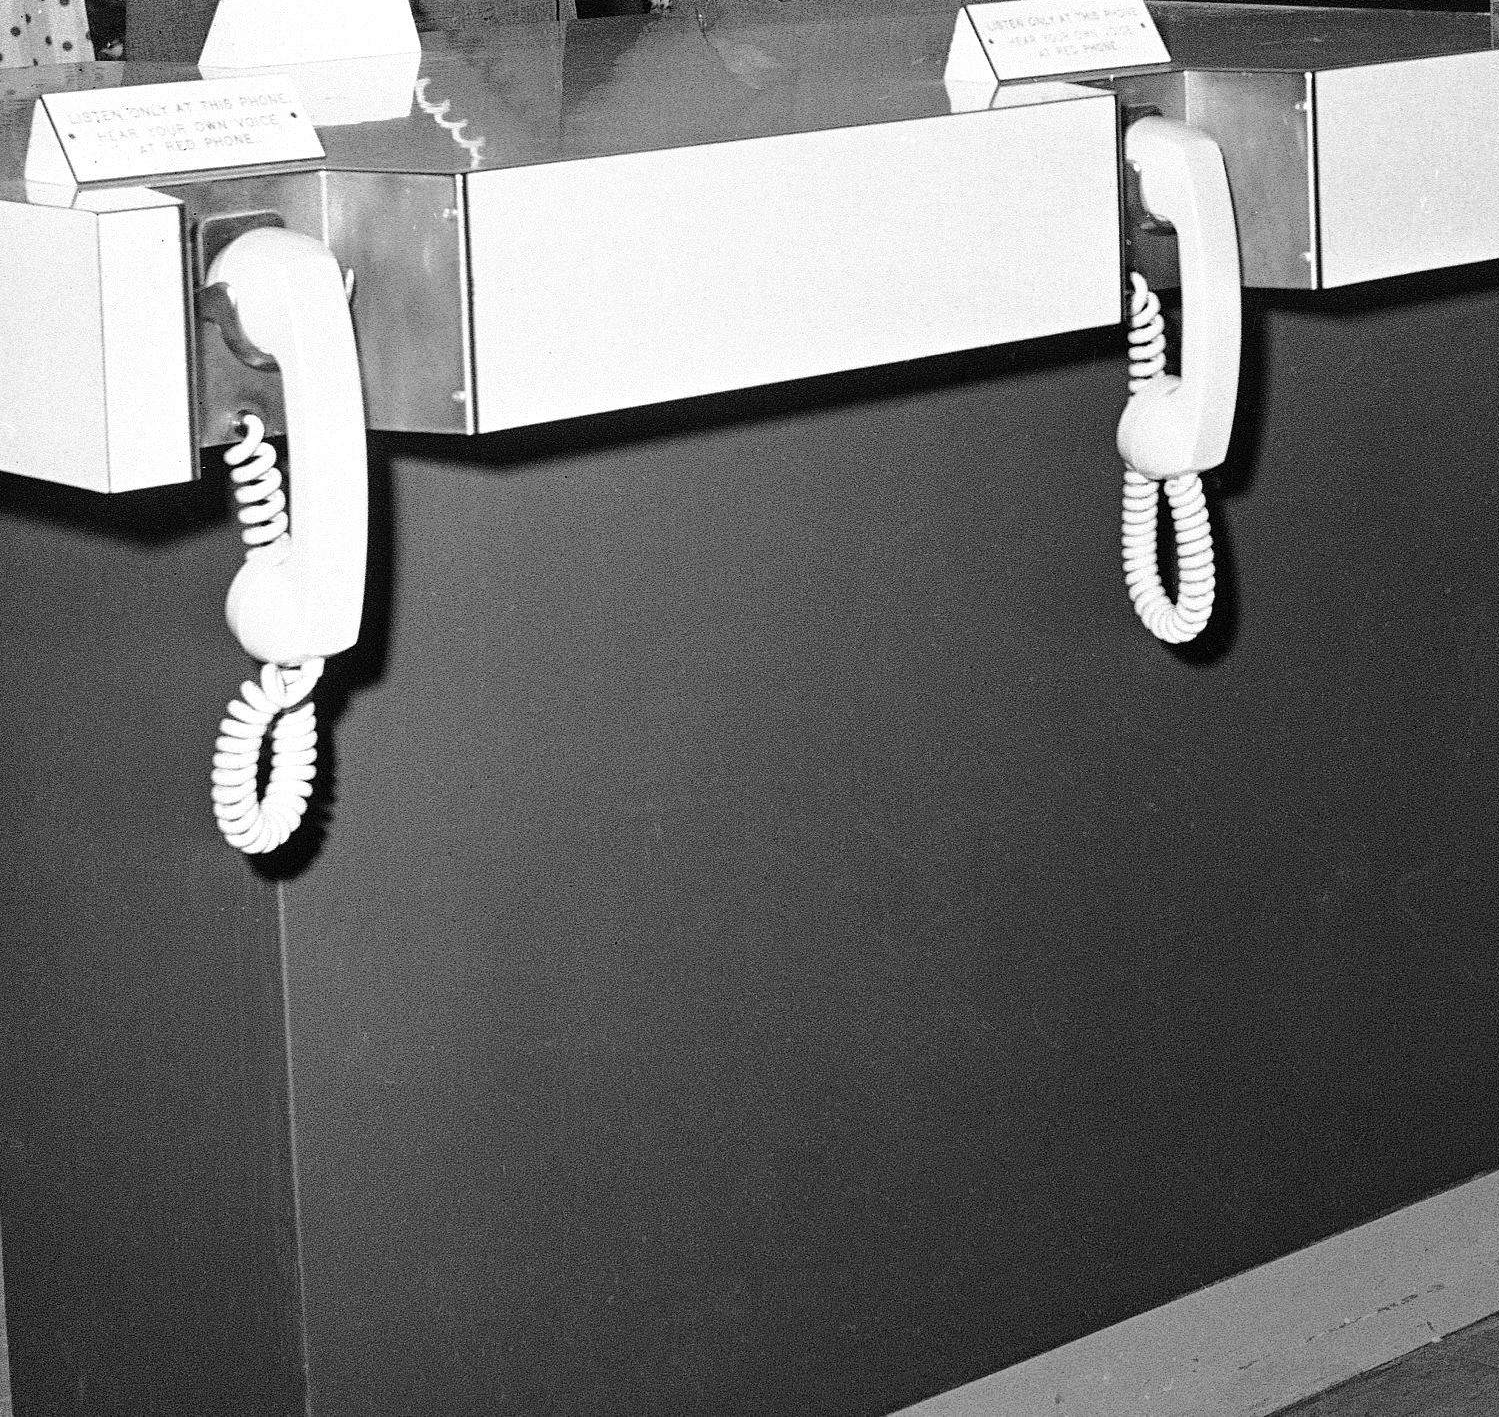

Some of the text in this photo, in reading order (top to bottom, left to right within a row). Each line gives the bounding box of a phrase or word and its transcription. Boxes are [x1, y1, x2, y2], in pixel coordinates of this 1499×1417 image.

[67, 109, 125, 126] LISTEN
[126, 103, 169, 119] ONLY
[175, 101, 193, 113] AT
[199, 97, 234, 110] THIS
[96, 113, 280, 142] HEAR YOUR OWN VOICE
[139, 142, 156, 155] AT
[164, 138, 197, 152] RED
